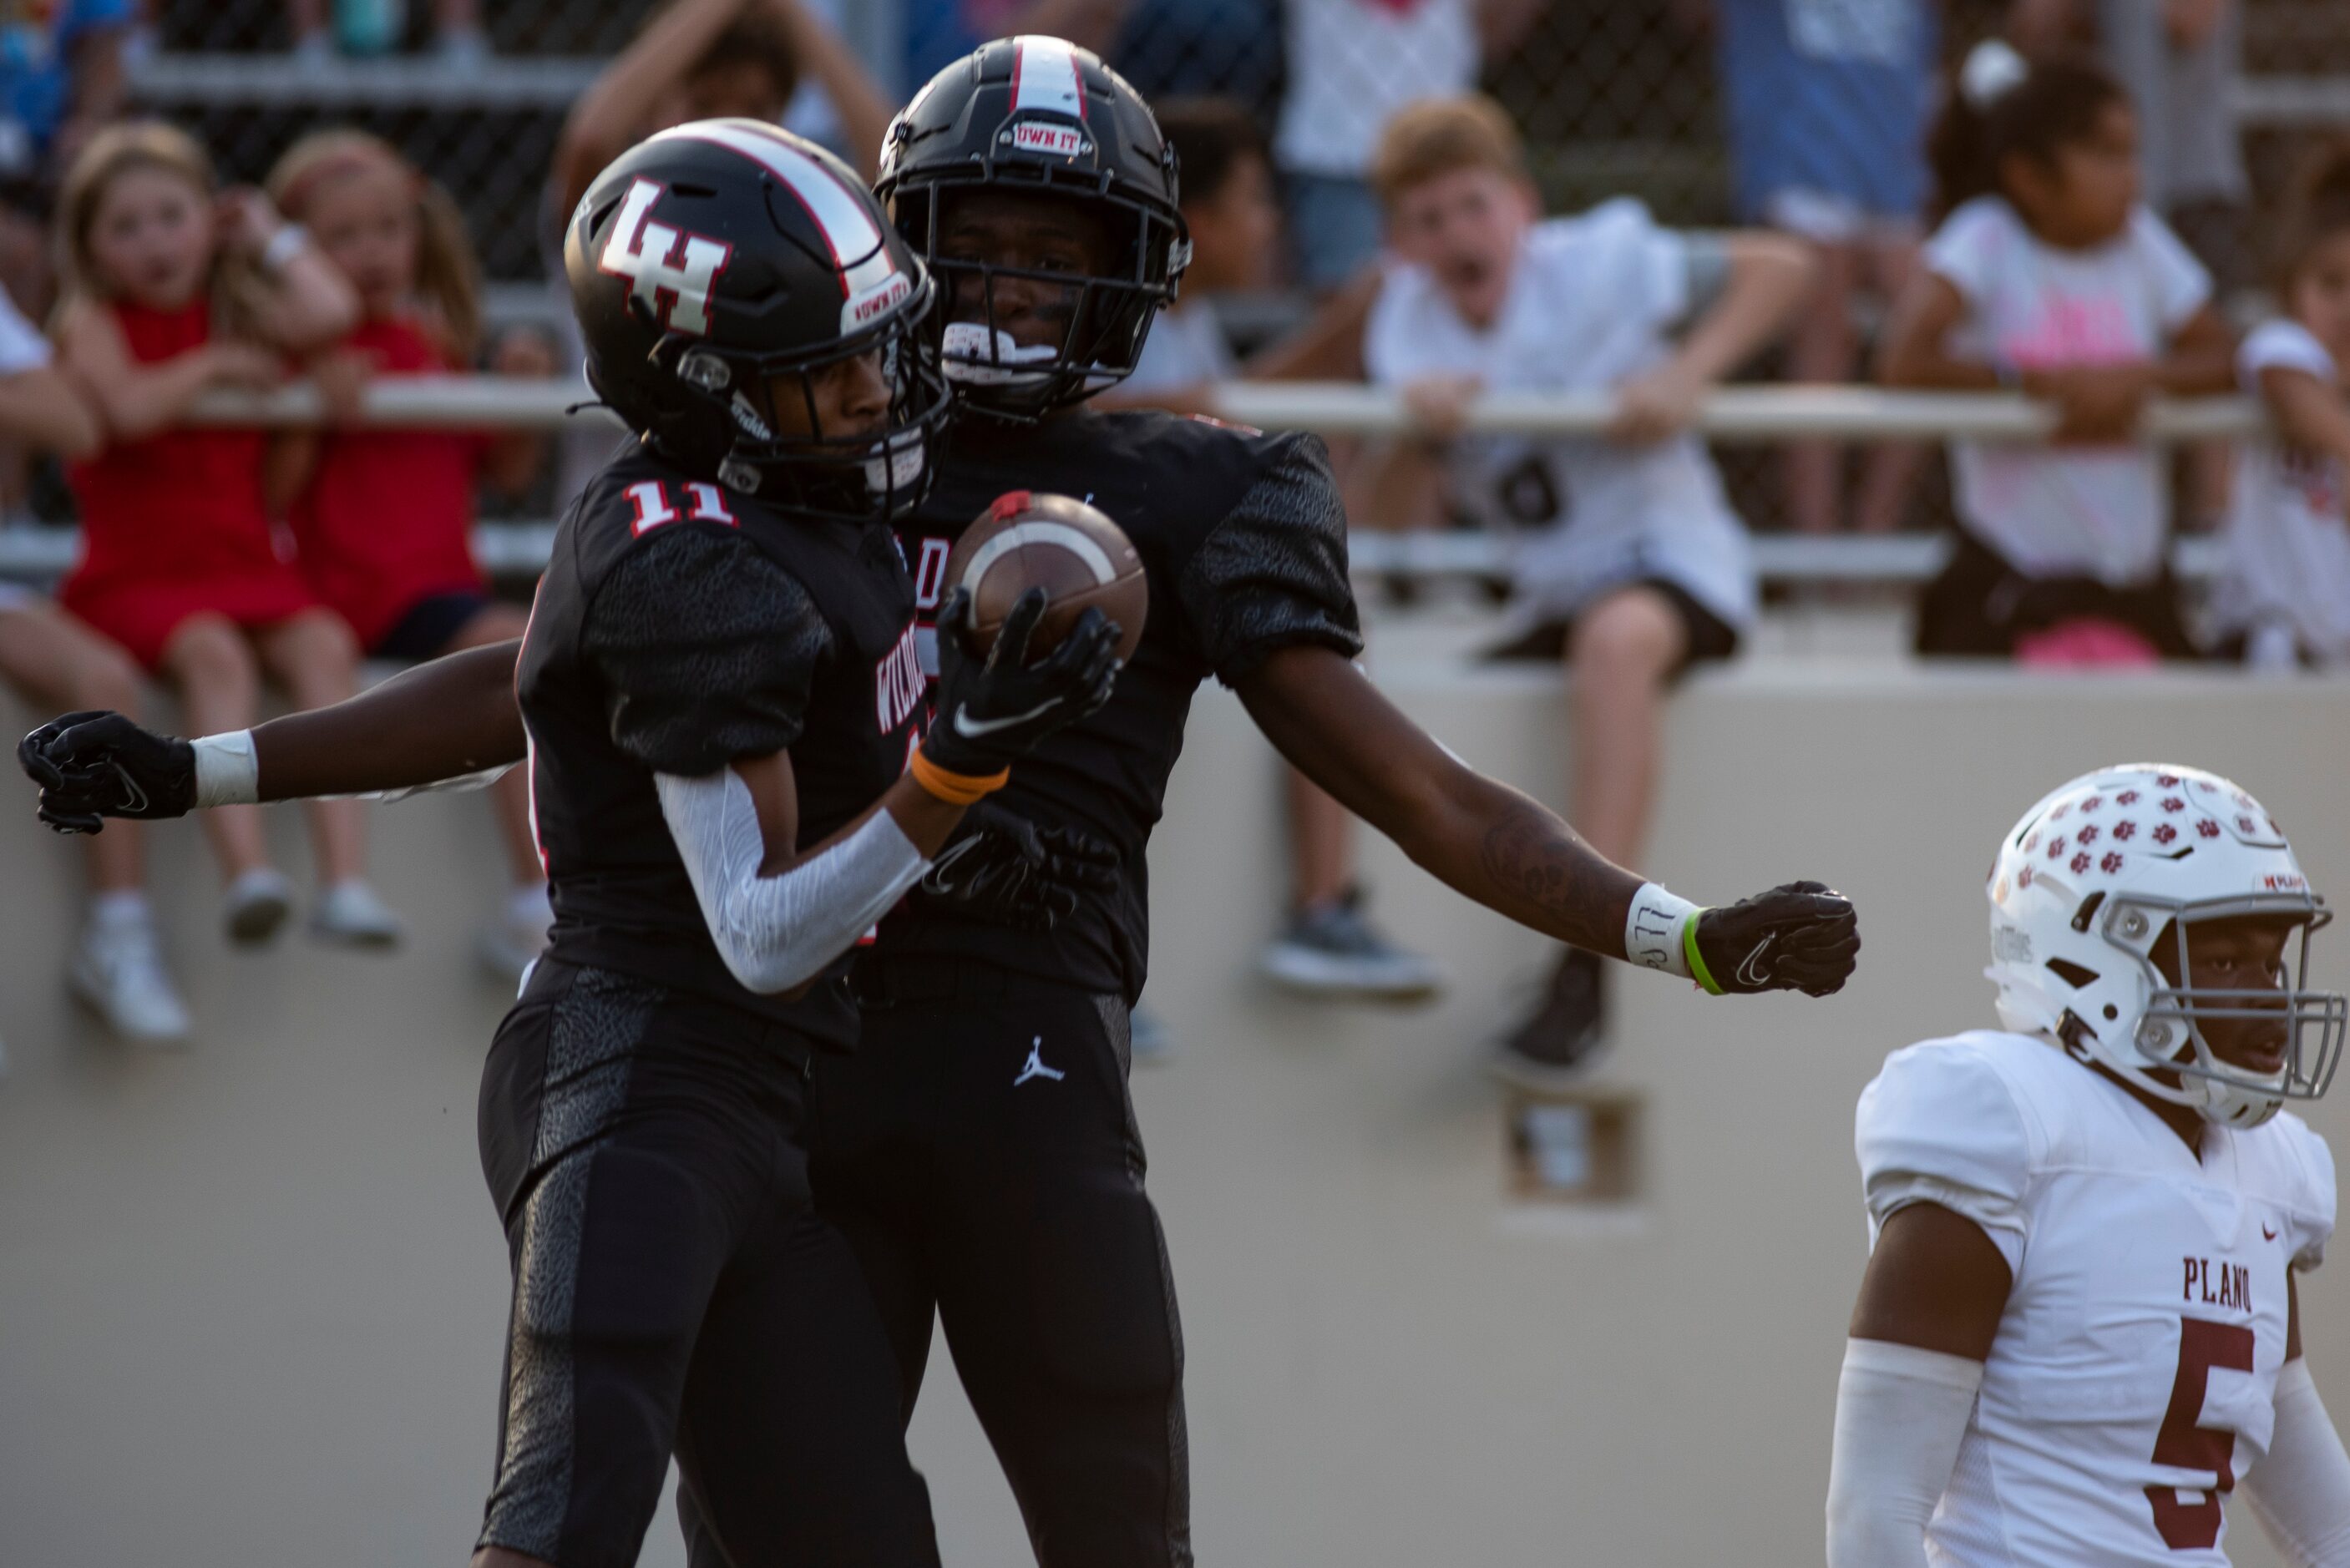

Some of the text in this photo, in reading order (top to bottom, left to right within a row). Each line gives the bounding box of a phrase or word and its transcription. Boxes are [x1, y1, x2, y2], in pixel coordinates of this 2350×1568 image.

[1017, 126, 1077, 149] OWN IT
[622, 479, 740, 539] 11
[876, 616, 927, 736] WILDC
[2183, 1257, 2252, 1314] PLANO
[2142, 1316, 2254, 1551] 5
